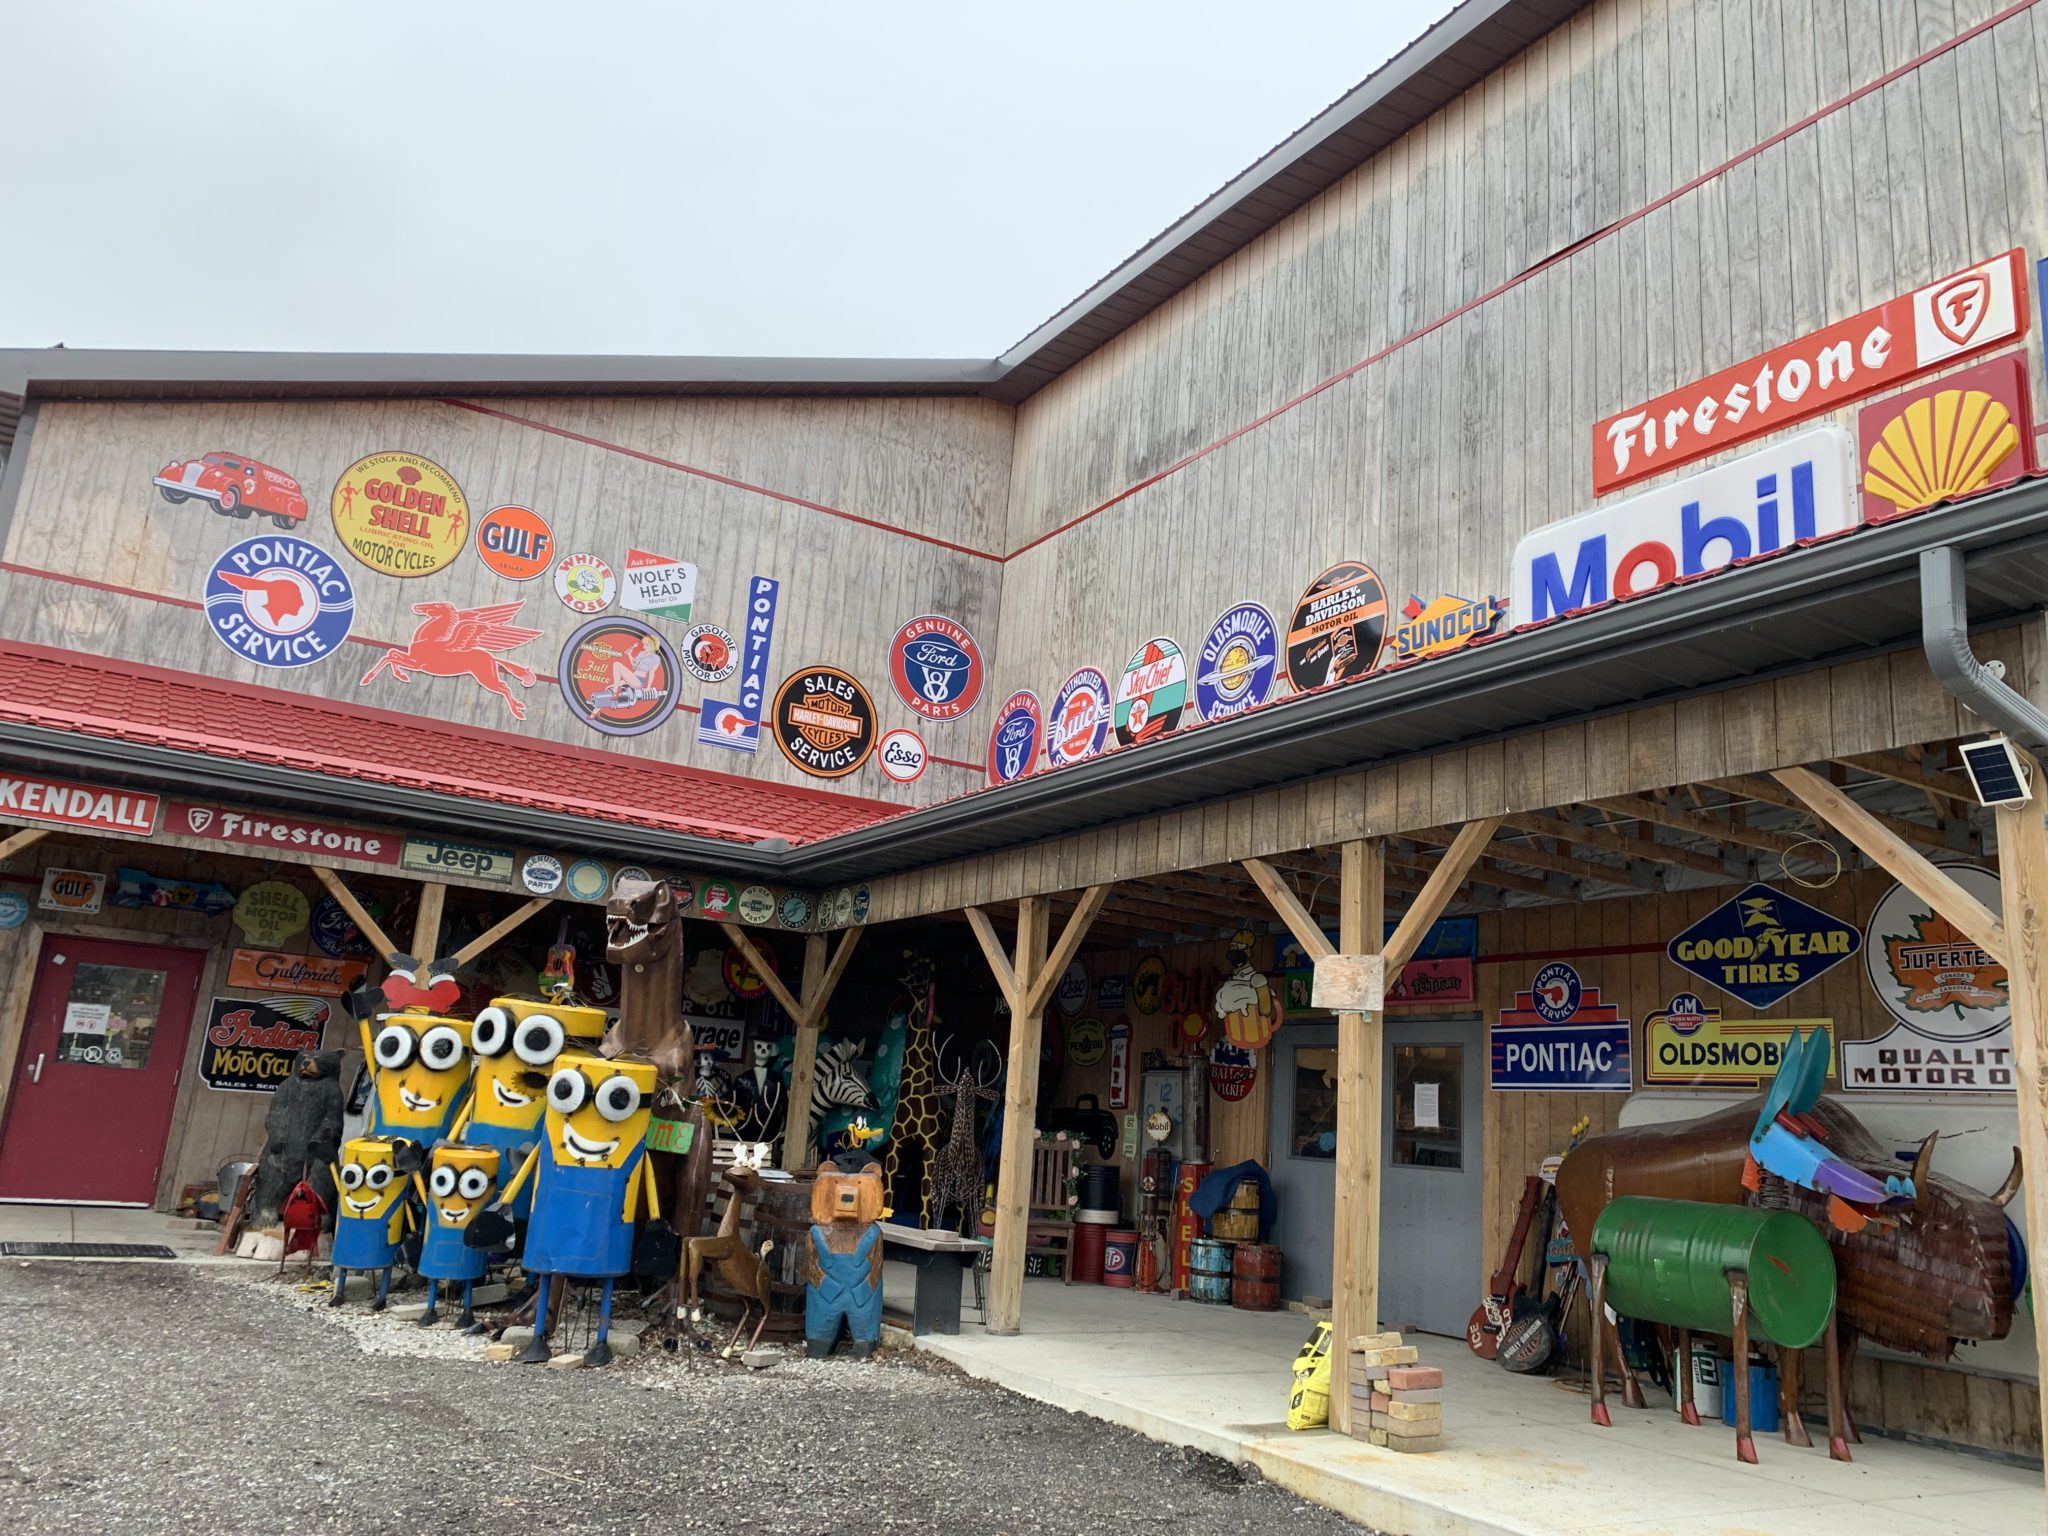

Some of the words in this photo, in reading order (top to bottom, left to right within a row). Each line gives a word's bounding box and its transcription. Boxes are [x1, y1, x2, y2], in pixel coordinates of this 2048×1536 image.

[1606, 325, 1893, 475] Firestone
[263, 470, 295, 489] TEXACO
[355, 463, 369, 473] WE
[371, 455, 397, 466] STOCK
[399, 456, 418, 465] AND
[420, 461, 461, 504] RECOMMEND
[365, 478, 447, 518] GOLDEN
[368, 504, 431, 539] SHELL
[387, 540, 405, 549] FOR
[420, 540, 435, 549] OIL
[482, 521, 549, 562] GULF
[1532, 461, 1816, 622] Mobil
[352, 538, 393, 567] MOTOR
[395, 549, 436, 570] CYCLES
[231, 541, 345, 597] PONTIAC
[559, 554, 613, 579] WHITE
[629, 568, 686, 585] WOLF'S
[640, 582, 682, 598] HEAD
[1310, 584, 1361, 612] HARLEY-
[561, 593, 607, 612] ROSE
[1305, 594, 1367, 626] DAVIDSON
[906, 620, 971, 650] GENUINE
[1311, 616, 1342, 635] MOTOR
[1344, 611, 1359, 623] OIL
[1397, 602, 1487, 654] SUNOCO
[218, 613, 327, 661] SERVICE
[691, 625, 736, 652] GASOLINE
[743, 579, 772, 709] PONTIAC
[1203, 610, 1270, 663] OLDSMOBILE
[584, 660, 608, 673] Full
[682, 649, 711, 680] MOTOR
[713, 663, 734, 680] OILS
[916, 643, 957, 667] Ford
[574, 668, 611, 684] Service
[804, 675, 855, 701] SALES
[1061, 671, 1102, 702] AUTHORIZED
[1126, 672, 1147, 697] Sky
[1146, 662, 1173, 689] Chief
[810, 700, 845, 714] MOTOR
[911, 696, 960, 717] PARTS
[998, 697, 1037, 726] GENUINE
[793, 709, 859, 732] HARLEY-DAVIDSON
[1003, 721, 1027, 743] Ford
[807, 728, 842, 743] CYCLES
[790, 737, 856, 768] SERVICE
[884, 741, 922, 768] Esso
[0, 778, 150, 828] KENDALL
[220, 812, 381, 855] Firestone
[426, 845, 493, 876] Jeep
[527, 854, 561, 872] GENUINE
[53, 879, 93, 898] GULF
[528, 881, 554, 890] PARTS
[249, 891, 300, 912] SHELL
[245, 908, 297, 923] MOTOR
[258, 919, 281, 931] OIL
[1677, 937, 1754, 961] GOOD
[1768, 931, 1850, 957] YEAR
[256, 954, 343, 984] Gulfpride
[1900, 948, 2000, 970] SUPERTES
[1535, 966, 1577, 989] PONTIAC
[1721, 962, 1800, 984] TIRES
[1940, 972, 1970, 980] CANADA'S
[1061, 972, 1086, 999] Esso
[1101, 979, 1124, 997] Ford
[705, 1001, 736, 1016] OIL
[1538, 1001, 1576, 1019] SERVICE
[1673, 998, 1697, 1014] GM
[209, 1009, 319, 1050] Indian
[691, 1024, 740, 1052] rage
[1506, 1041, 1613, 1073] PONTIAC
[1659, 1042, 1809, 1066] OLDSMOBI
[1878, 1049, 2010, 1066] QUALIT
[215, 1080, 247, 1088] SALES
[1211, 1066, 1233, 1079] BAIT
[1854, 1067, 1976, 1085] MOTOR
[1160, 1083, 1172, 1102] 12
[1148, 1121, 1169, 1131] Mobil
[1181, 1177, 1195, 1292] SHELL
[1470, 1322, 1483, 1349] ICE
[1503, 1319, 1542, 1360] HARLEY-DAVIDSON
